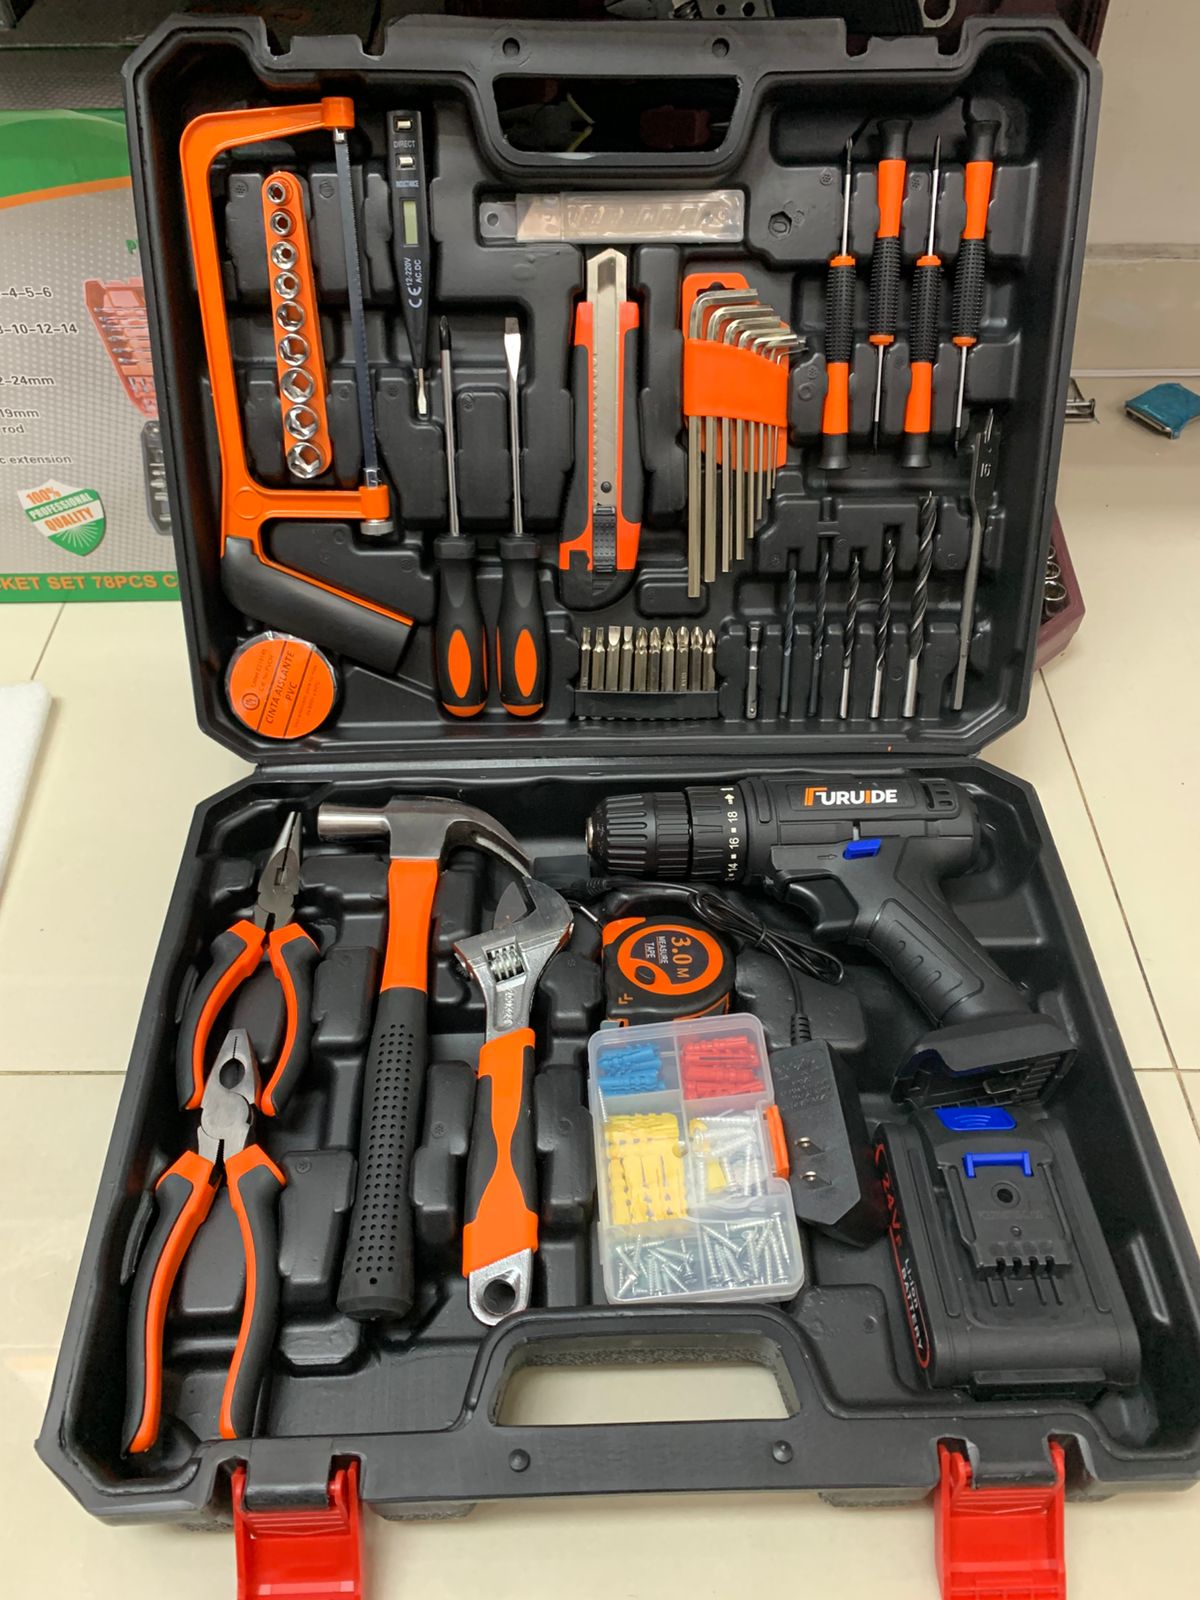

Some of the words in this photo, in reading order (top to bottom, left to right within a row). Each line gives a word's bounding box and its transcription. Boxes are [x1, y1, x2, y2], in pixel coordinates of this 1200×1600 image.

[393, 140, 416, 149] DIRECT
[2, 424, 25, 434] rod
[9, 454, 73, 464] extension
[26, 487, 62, 505] 100%
[28, 492, 94, 520] PROFESSIONAL
[44, 507, 95, 532] QUALITY
[0, 576, 41, 591] KET
[47, 576, 86, 590] SET
[91, 575, 158, 589] 78PCS
[265, 694, 281, 724] CINTA
[277, 650, 295, 696] AISLANTE
[285, 682, 298, 702] PVC
[805, 787, 898, 806] FURUIDE
[727, 811, 738, 823] 18
[729, 837, 740, 849] 16
[728, 862, 738, 872] 14
[646, 942, 656, 958] TAPE
[658, 936, 669, 964] MEASURE
[671, 936, 693, 965] 3.0
[676, 967, 690, 978] M
[901, 1267, 923, 1350] BATTERY
